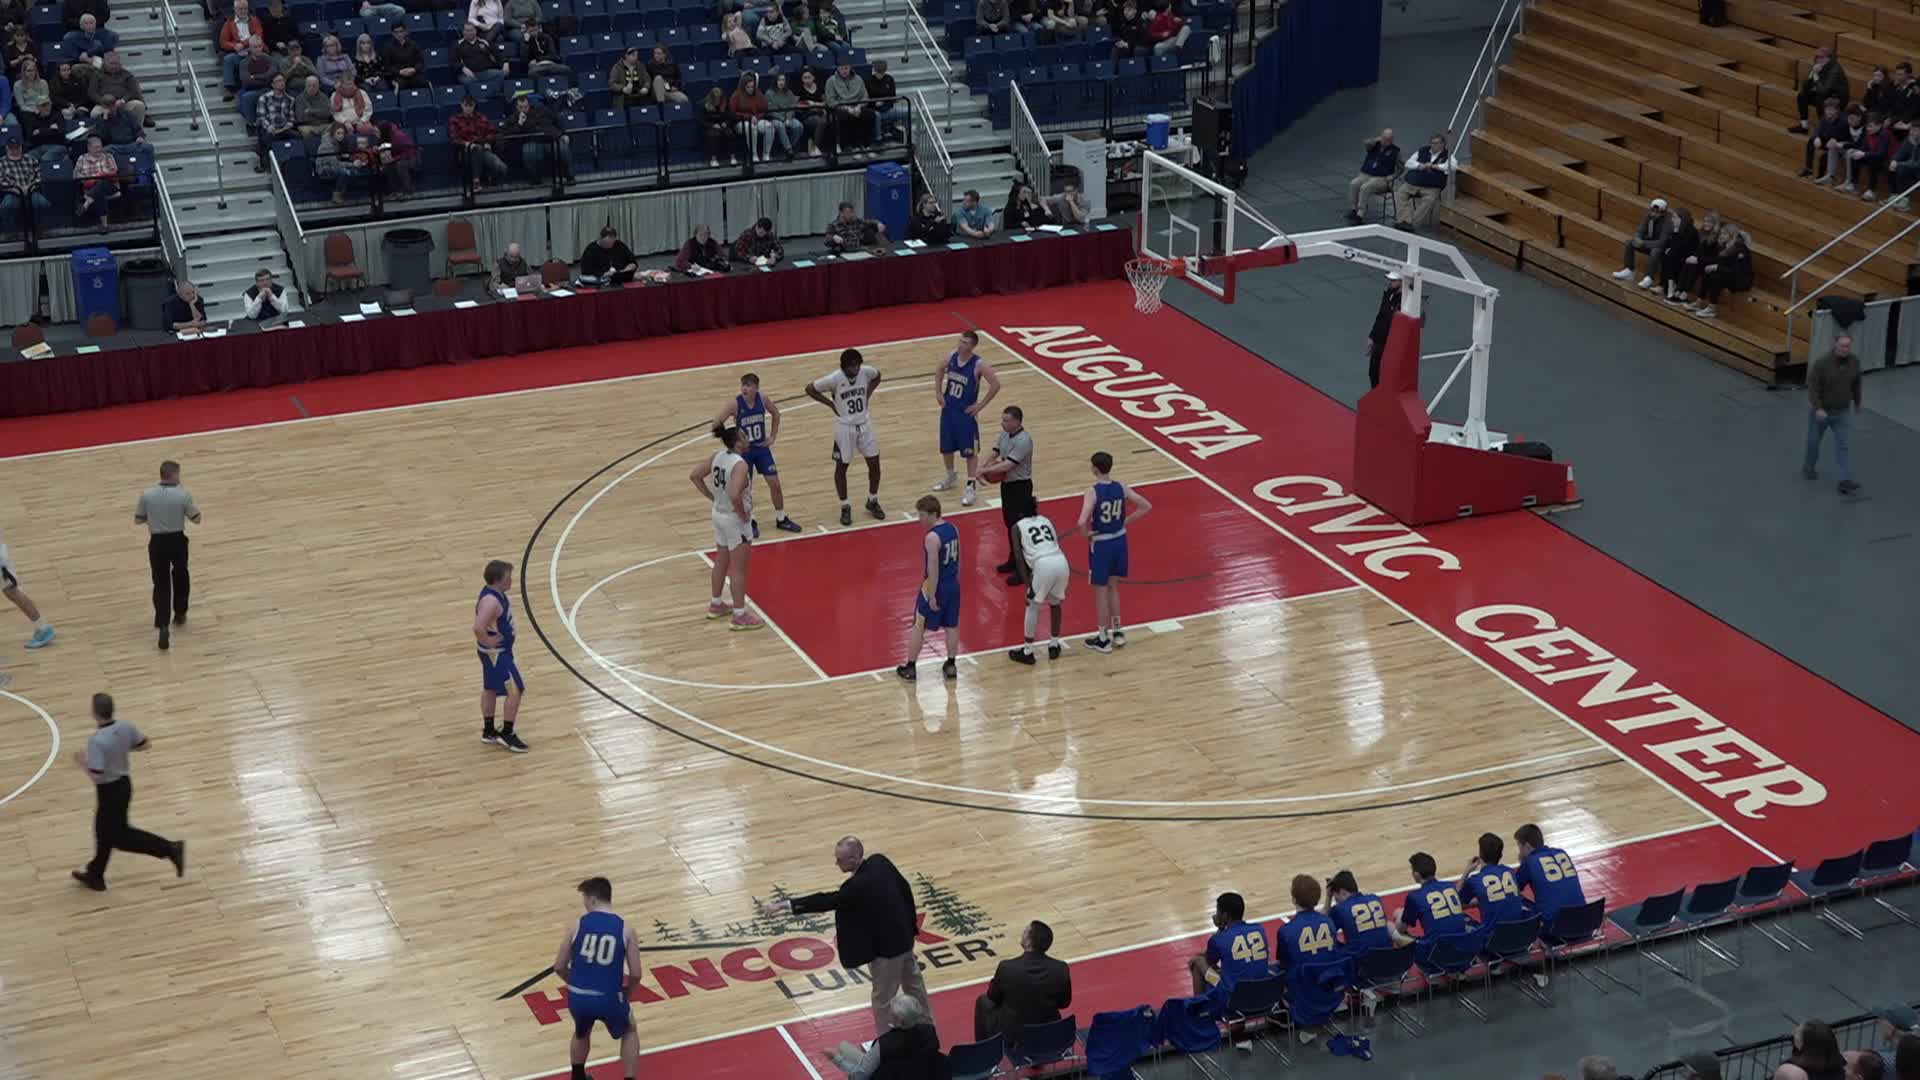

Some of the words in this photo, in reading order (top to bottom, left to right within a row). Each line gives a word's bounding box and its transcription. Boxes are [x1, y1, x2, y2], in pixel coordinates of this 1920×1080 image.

[847, 397, 864, 414] 30
[713, 465, 726, 490] 34
[1100, 499, 1122, 524] 34
[1028, 524, 1055, 545] 23
[1000, 325, 1263, 460] AUGUSTA
[1252, 474, 1461, 580] CIVIC
[1455, 604, 1828, 819] CENTER
[1539, 853, 1577, 882] 52
[1482, 871, 1519, 902] 24
[1351, 901, 1388, 933] 22
[1426, 887, 1463, 920] 20
[579, 933, 617, 966] 40
[1231, 931, 1268, 963] 42
[1298, 923, 1334, 955] 44
